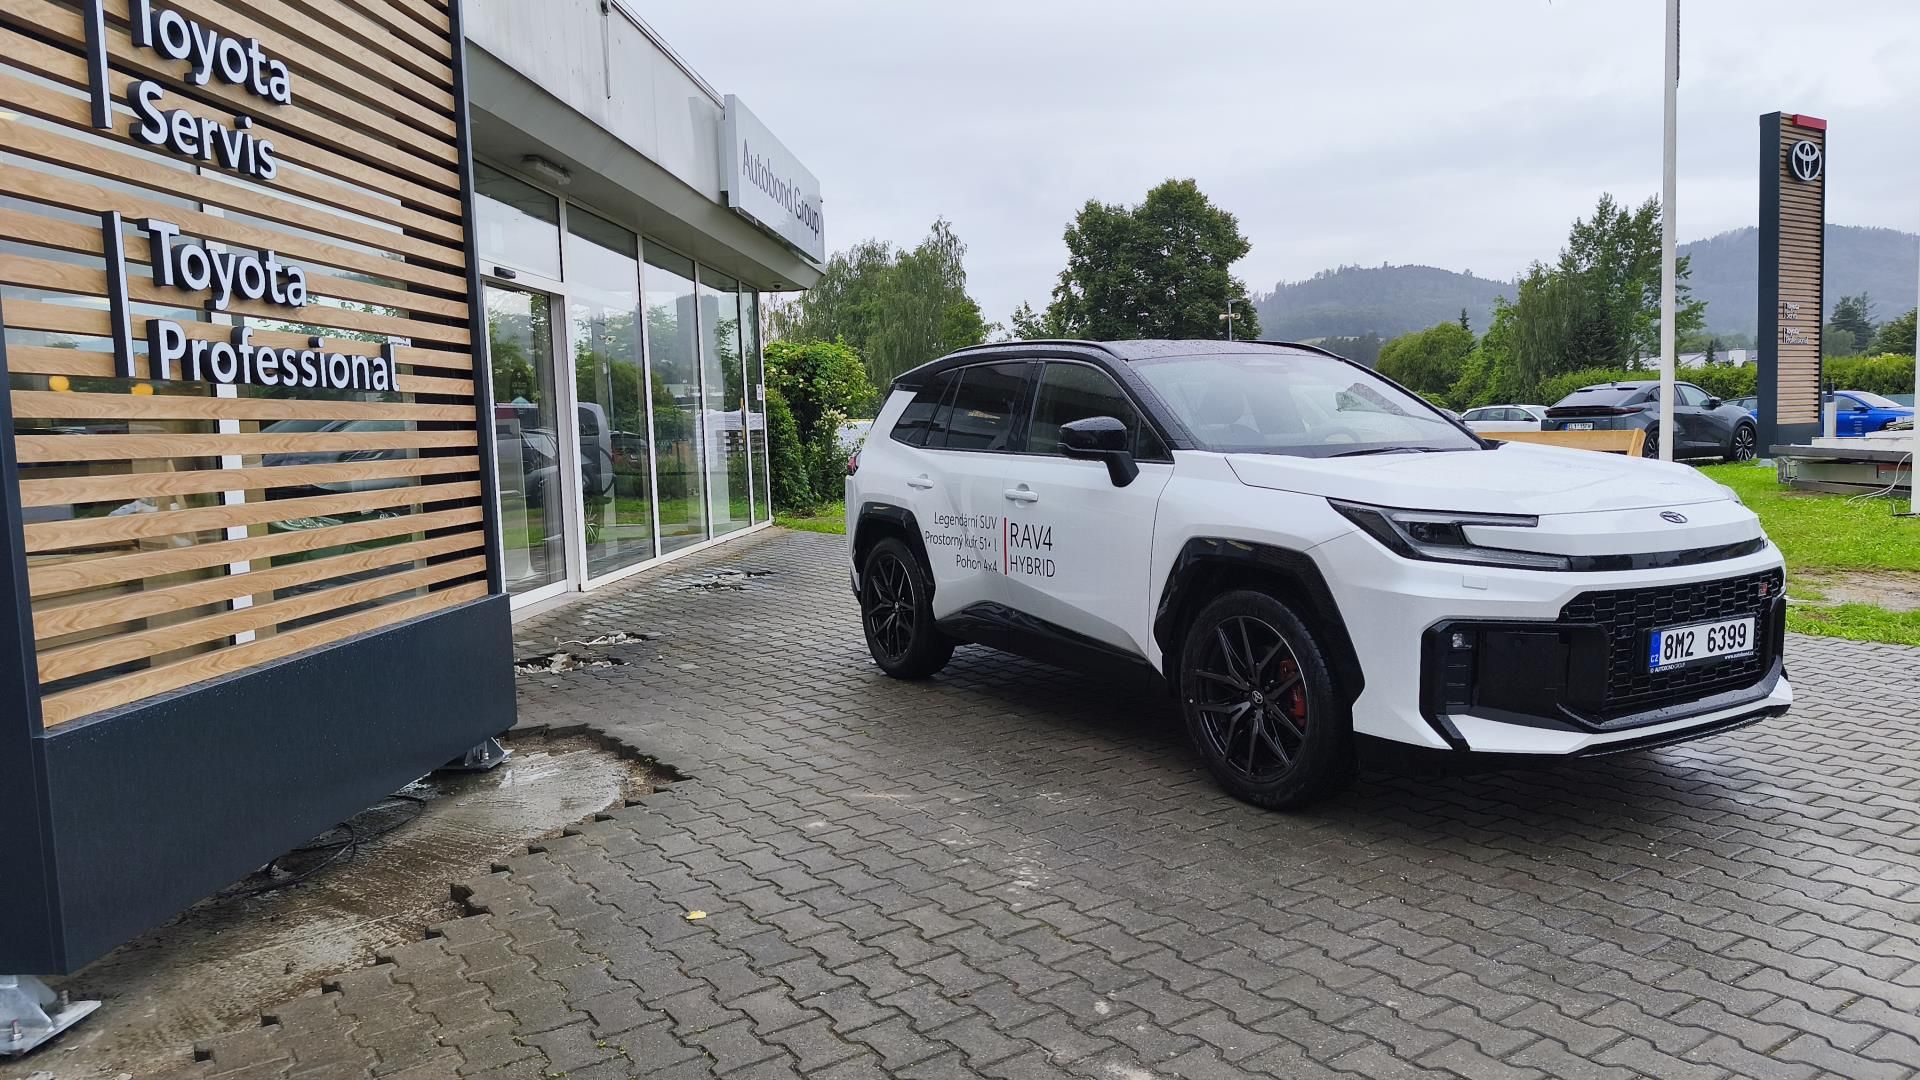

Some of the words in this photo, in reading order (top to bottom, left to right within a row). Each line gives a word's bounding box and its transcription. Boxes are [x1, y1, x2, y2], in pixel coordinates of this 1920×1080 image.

[128, 80, 278, 180] Servis
[743, 138, 793, 213] Autobond
[794, 186, 820, 240] Group
[138, 217, 308, 310] Toyota
[146, 317, 400, 392] Professional
[934, 511, 978, 529] Legendární
[979, 515, 998, 530] SUV
[925, 530, 963, 549] Prostorný
[1010, 522, 1053, 551] RAV4
[956, 554, 982, 570] Pohon
[983, 559, 998, 573] 4x4
[1010, 554, 1056, 577] HYBRID
[1663, 630, 1695, 661] 8M2
[1707, 622, 1747, 653] 6399
[1650, 654, 1659, 663] CZ
